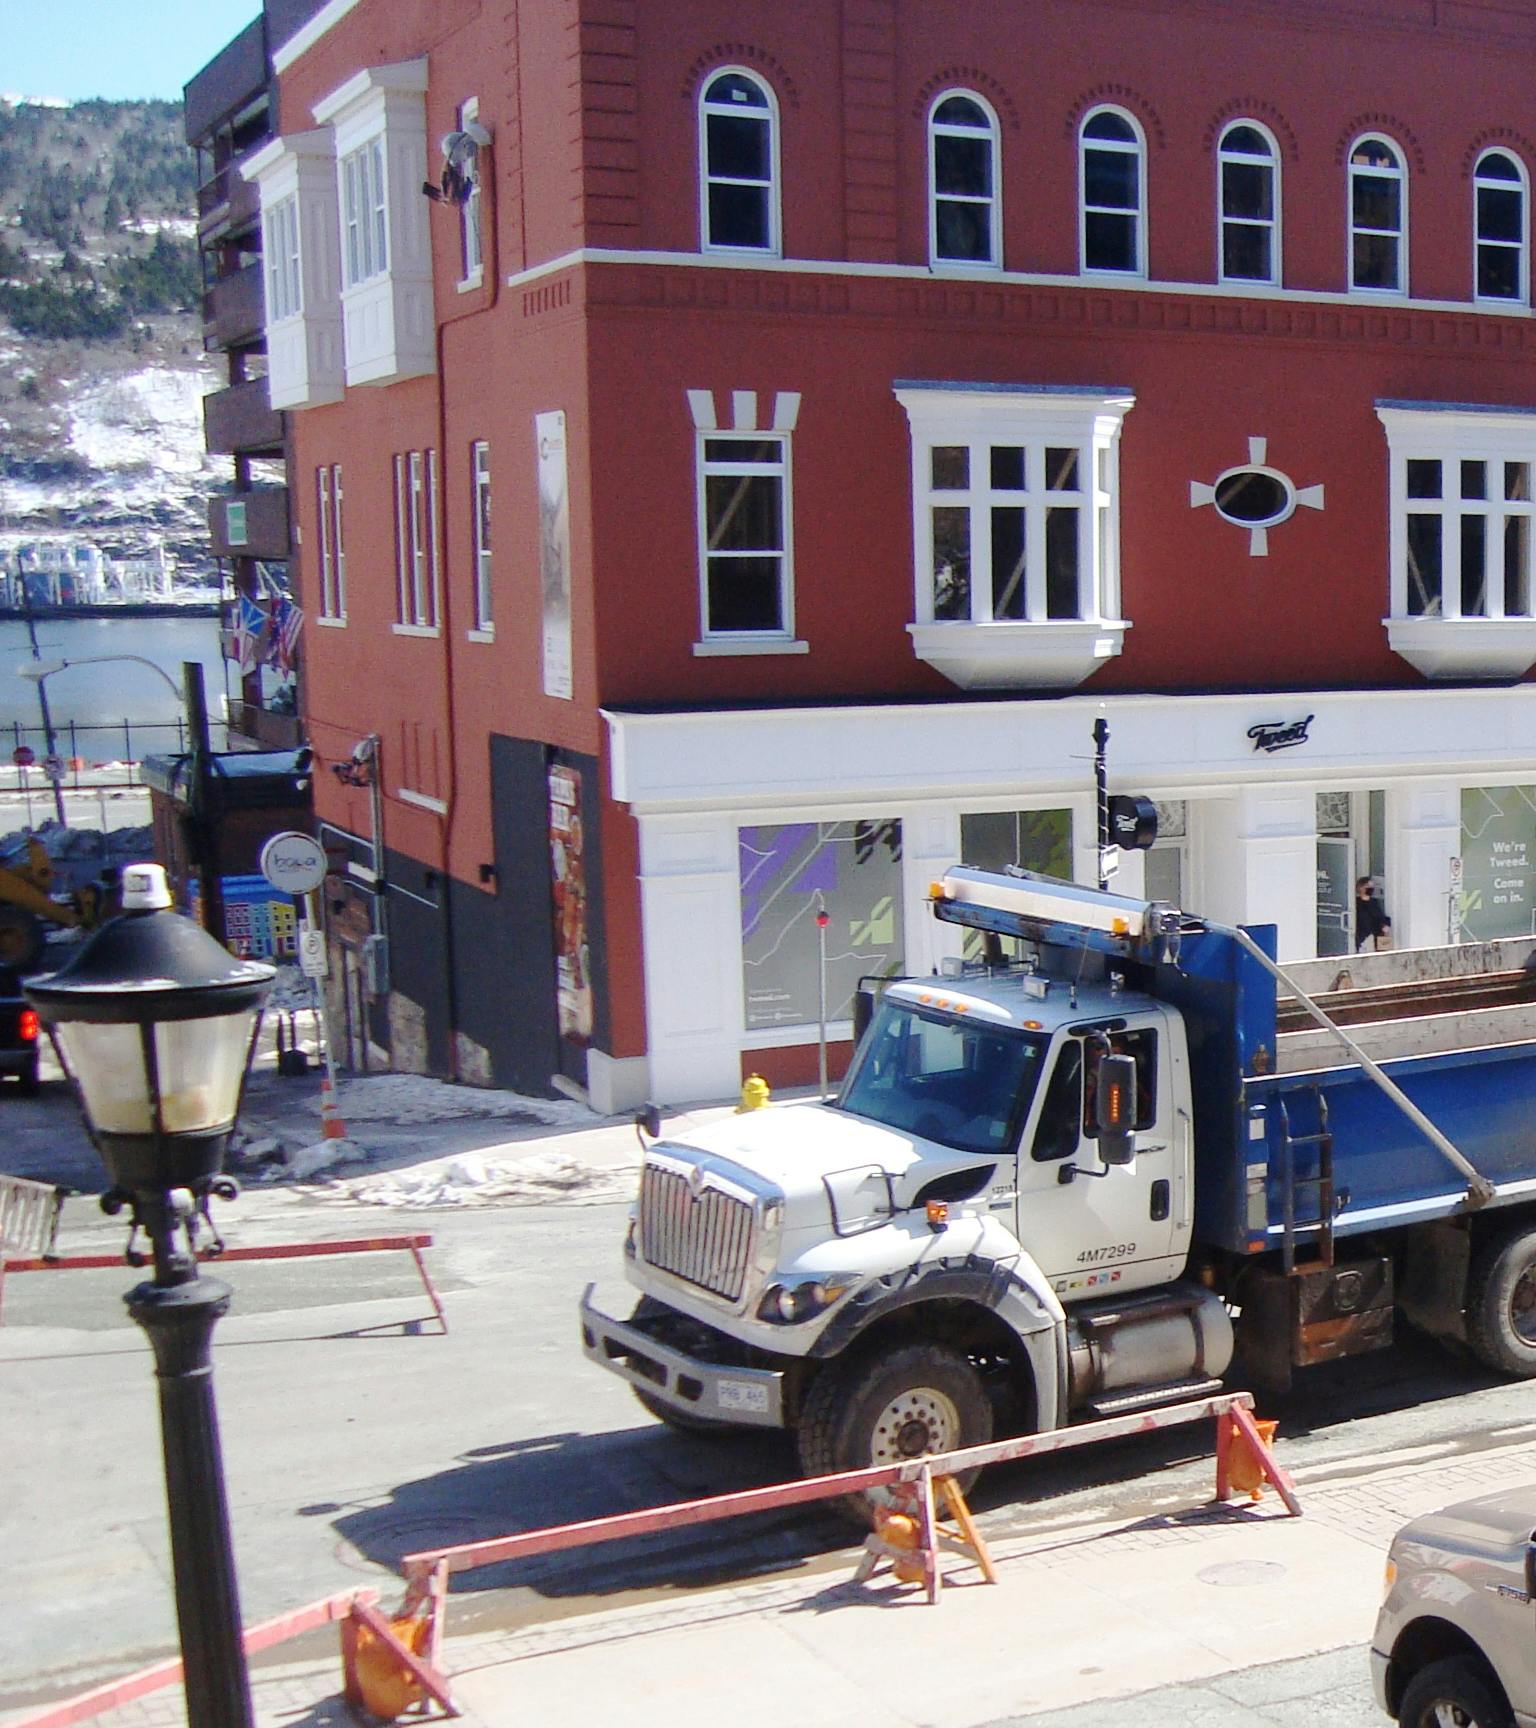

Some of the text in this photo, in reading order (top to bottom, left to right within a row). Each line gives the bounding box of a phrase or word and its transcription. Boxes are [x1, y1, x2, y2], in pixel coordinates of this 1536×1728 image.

[1247, 714, 1315, 753] Tweed
[1492, 841, 1527, 853] We're
[1490, 854, 1529, 868] Tweed.
[1494, 878, 1525, 889] Come
[1493, 893, 1507, 904] on
[1076, 1242, 1136, 1264] 4M7299
